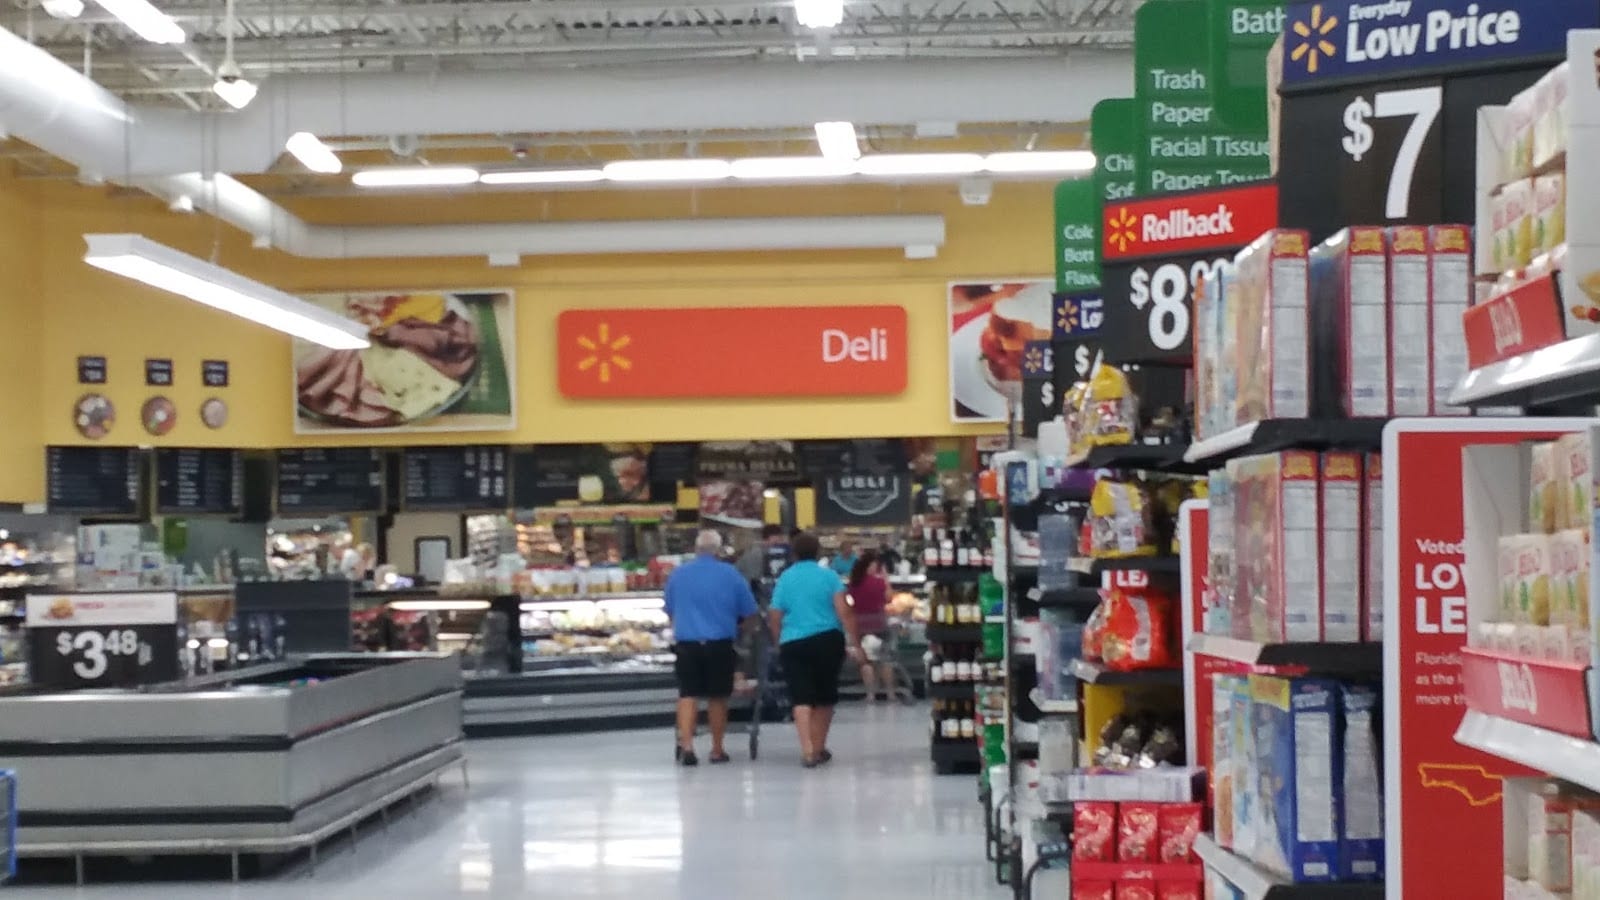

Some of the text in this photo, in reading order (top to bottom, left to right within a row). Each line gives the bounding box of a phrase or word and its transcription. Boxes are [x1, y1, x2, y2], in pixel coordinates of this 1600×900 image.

[1346, 4, 1520, 62] Low Price
[1151, 69, 1205, 89] Trash
[1151, 102, 1212, 127] Paper
[1151, 136, 1207, 156] Facial
[1142, 204, 1233, 242] Rollback
[822, 327, 887, 363] Deli
[841, 476, 886, 488] DELI
